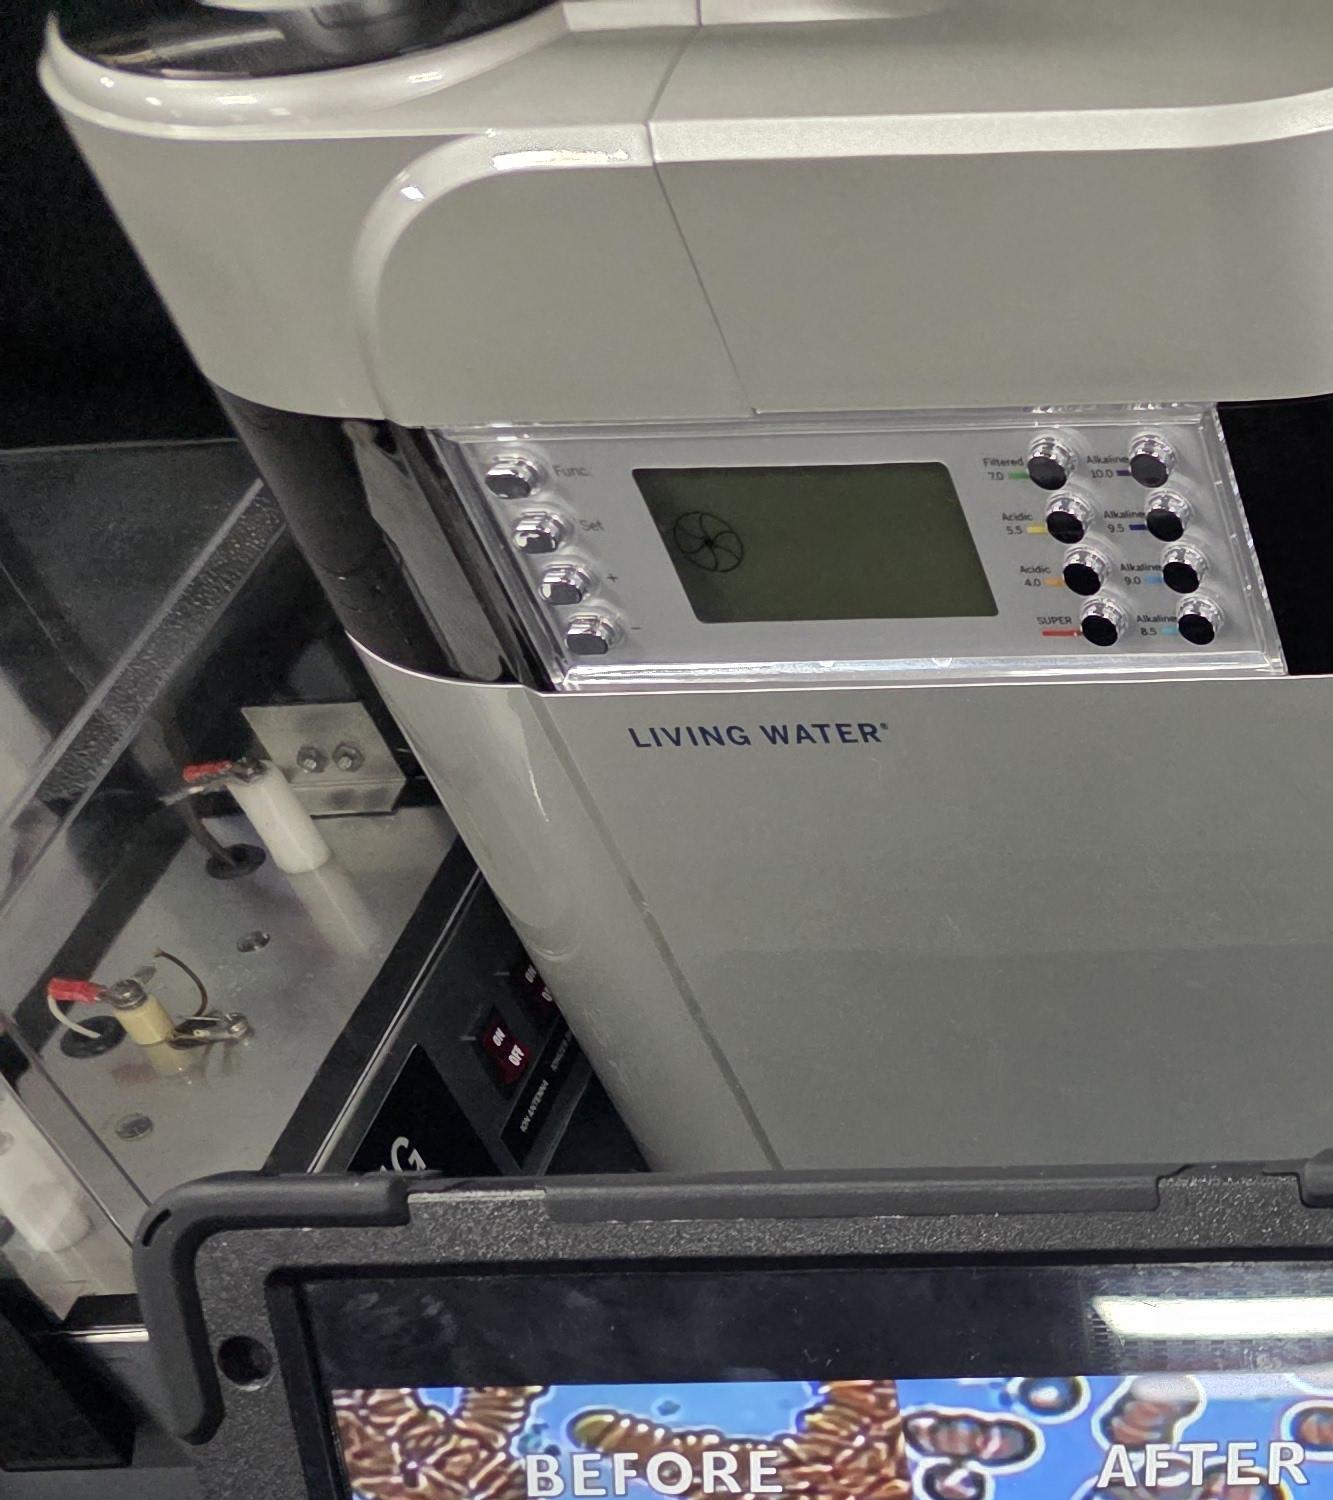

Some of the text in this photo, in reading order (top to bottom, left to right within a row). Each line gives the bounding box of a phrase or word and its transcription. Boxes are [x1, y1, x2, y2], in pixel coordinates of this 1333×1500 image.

[983, 457, 1024, 467] Filtered
[1087, 456, 1129, 464] Alkaline
[988, 472, 1004, 480] 7.0
[1091, 469, 1113, 478] 10.0
[1002, 512, 1032, 521] Acidic
[1104, 510, 1145, 519] Alkaline
[579, 520, 604, 531] Set
[1107, 524, 1124, 533] 9.5
[1006, 526, 1023, 535] 5.5
[1020, 565, 1051, 574] Acidic
[1120, 563, 1161, 572] Alkaline
[1024, 578, 1041, 587] 4.0
[1124, 576, 1141, 585] 9.0
[1036, 616, 1072, 625] SUPER
[1136, 615, 1177, 623] Alkaline
[1141, 627, 1157, 636] 8.5
[628, 726, 751, 748] LIVING
[492, 1027, 505, 1047] ON
[508, 1044, 525, 1067] OFF
[1097, 1441, 1308, 1488] AFTER
[526, 1450, 783, 1497] BEFORE
